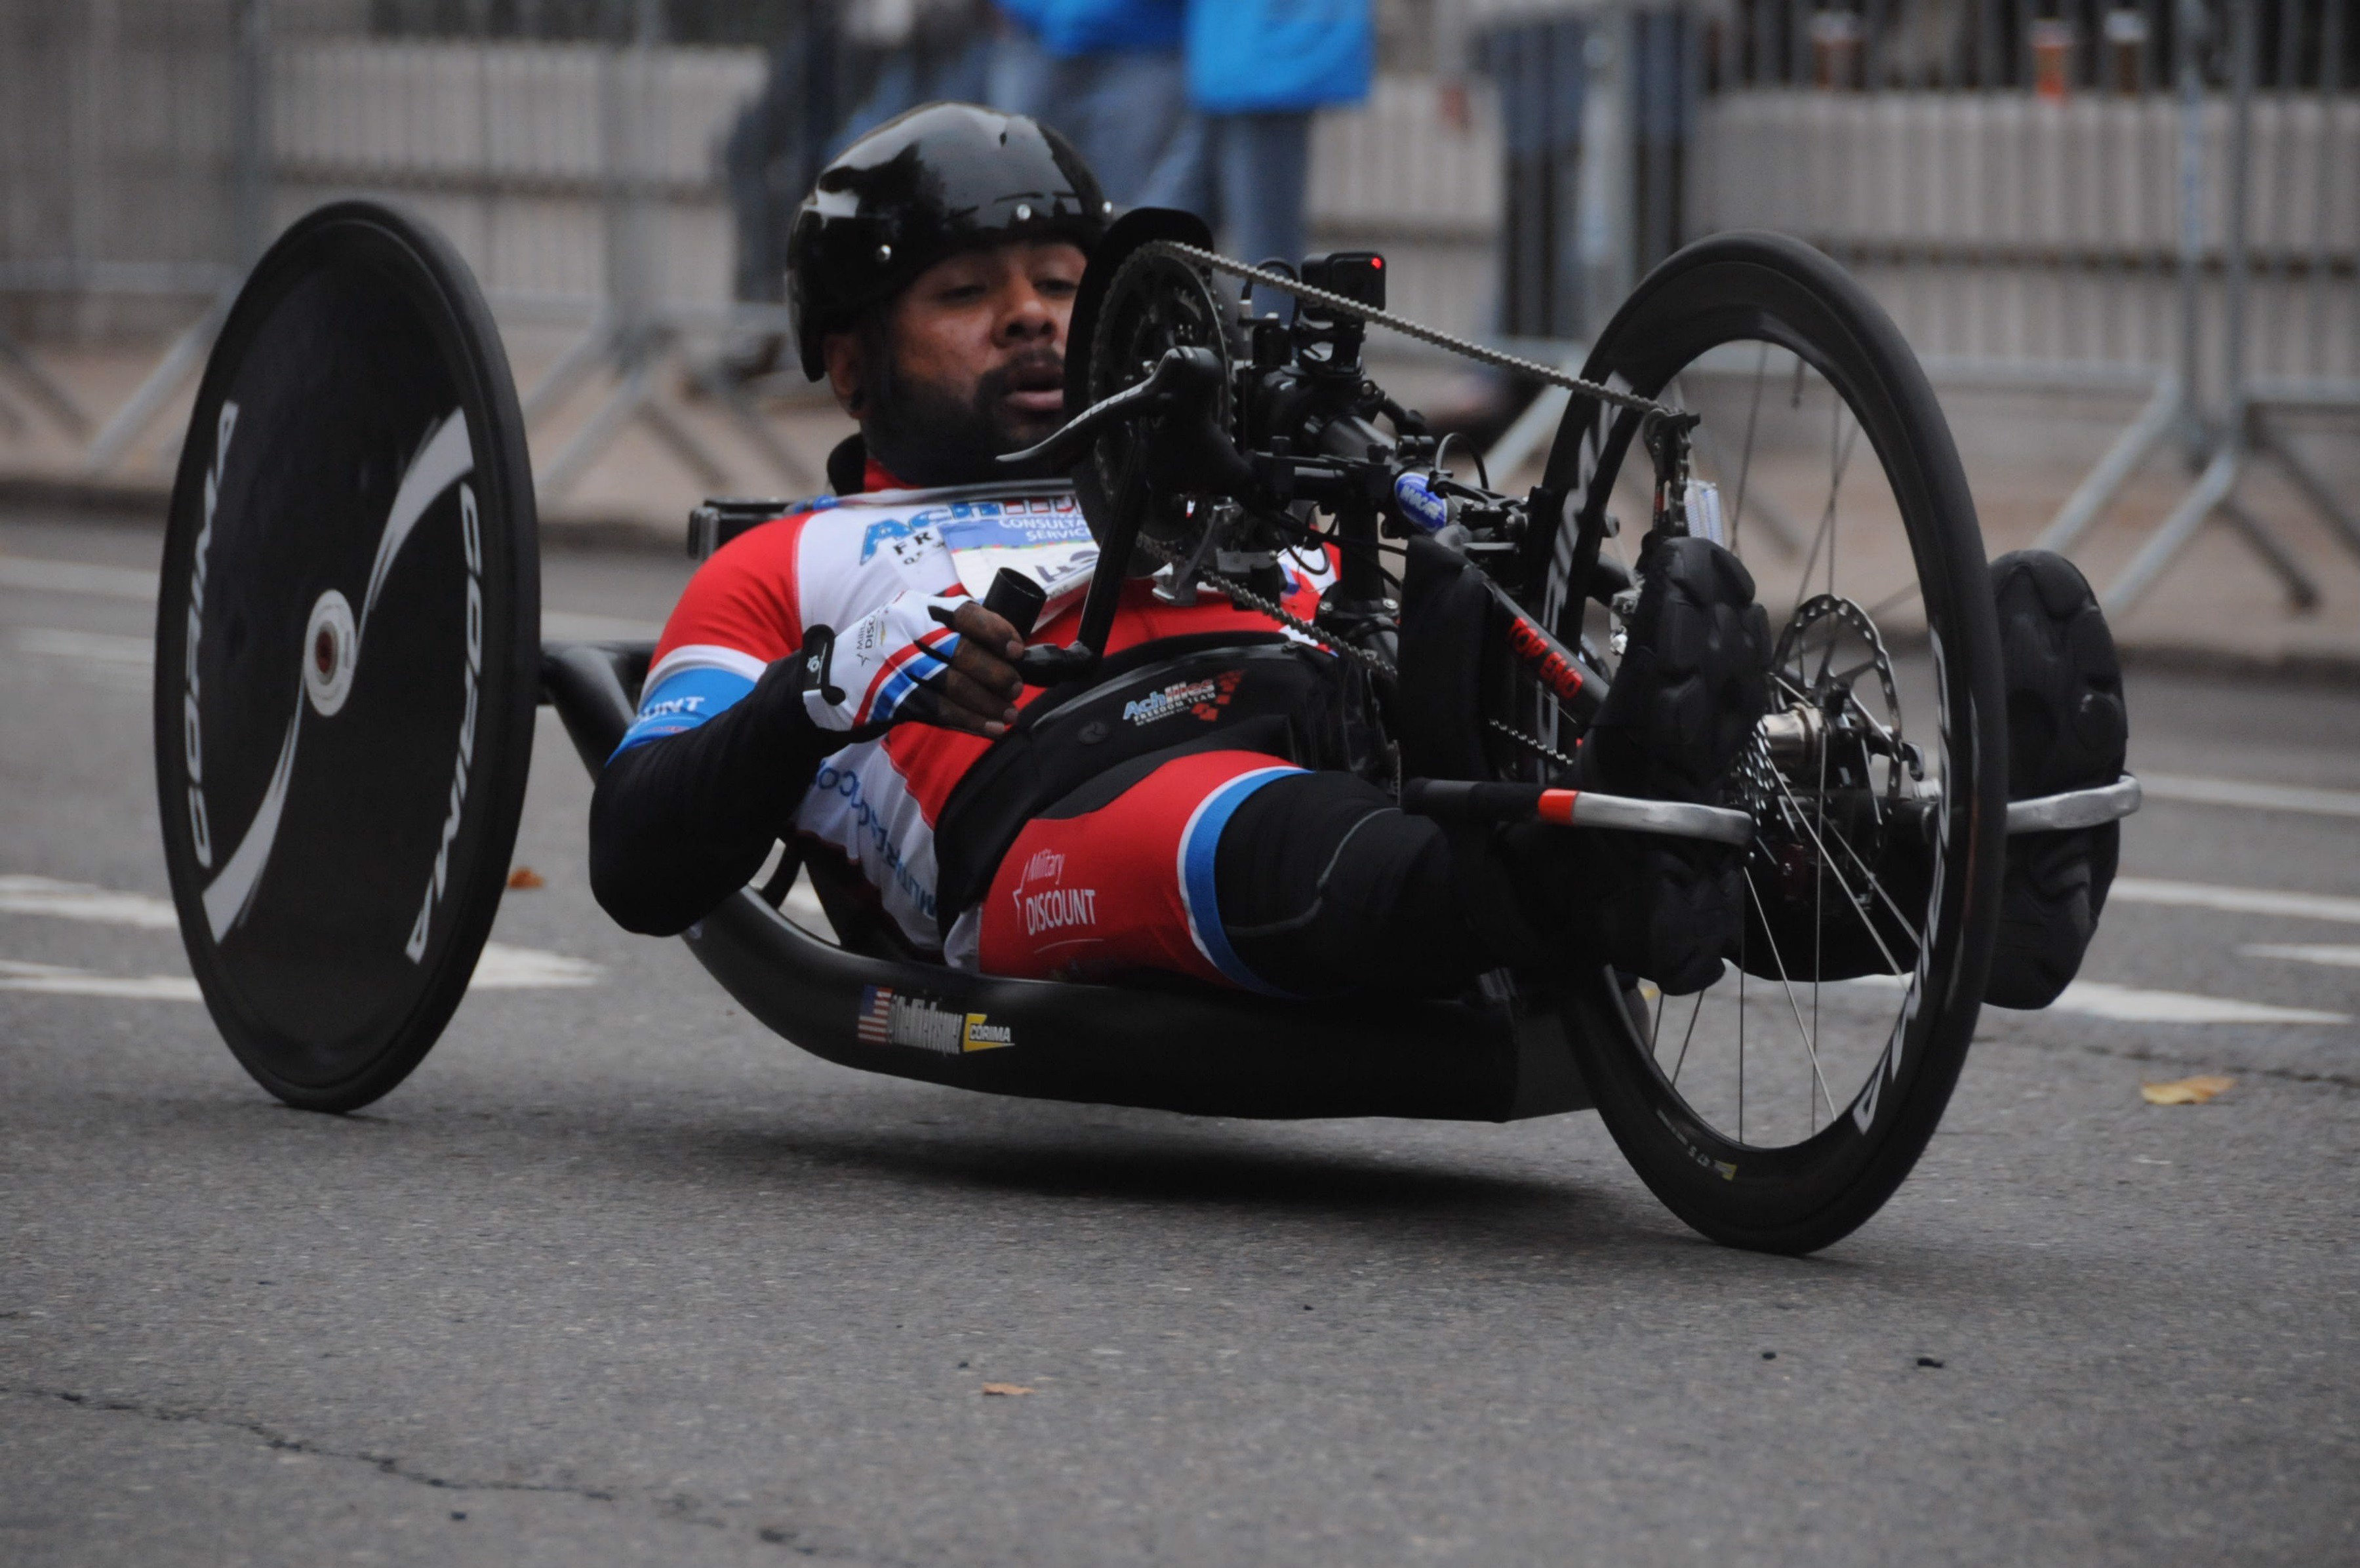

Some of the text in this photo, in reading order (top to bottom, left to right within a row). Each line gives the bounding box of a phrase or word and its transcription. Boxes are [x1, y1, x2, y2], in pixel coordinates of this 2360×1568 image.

[998, 517, 1087, 530] CONSULTA
[1026, 527, 1092, 542] SERVIC
[185, 400, 239, 870] CORIMA
[1509, 616, 1584, 700] TOP END
[1123, 679, 1214, 720] Achilles
[1134, 692, 1216, 722] FREEDOM TEAM
[405, 481, 482, 964] CORIMA
[1025, 889, 1096, 936] DISCOUNT
[969, 1024, 1011, 1042] CORIMA
